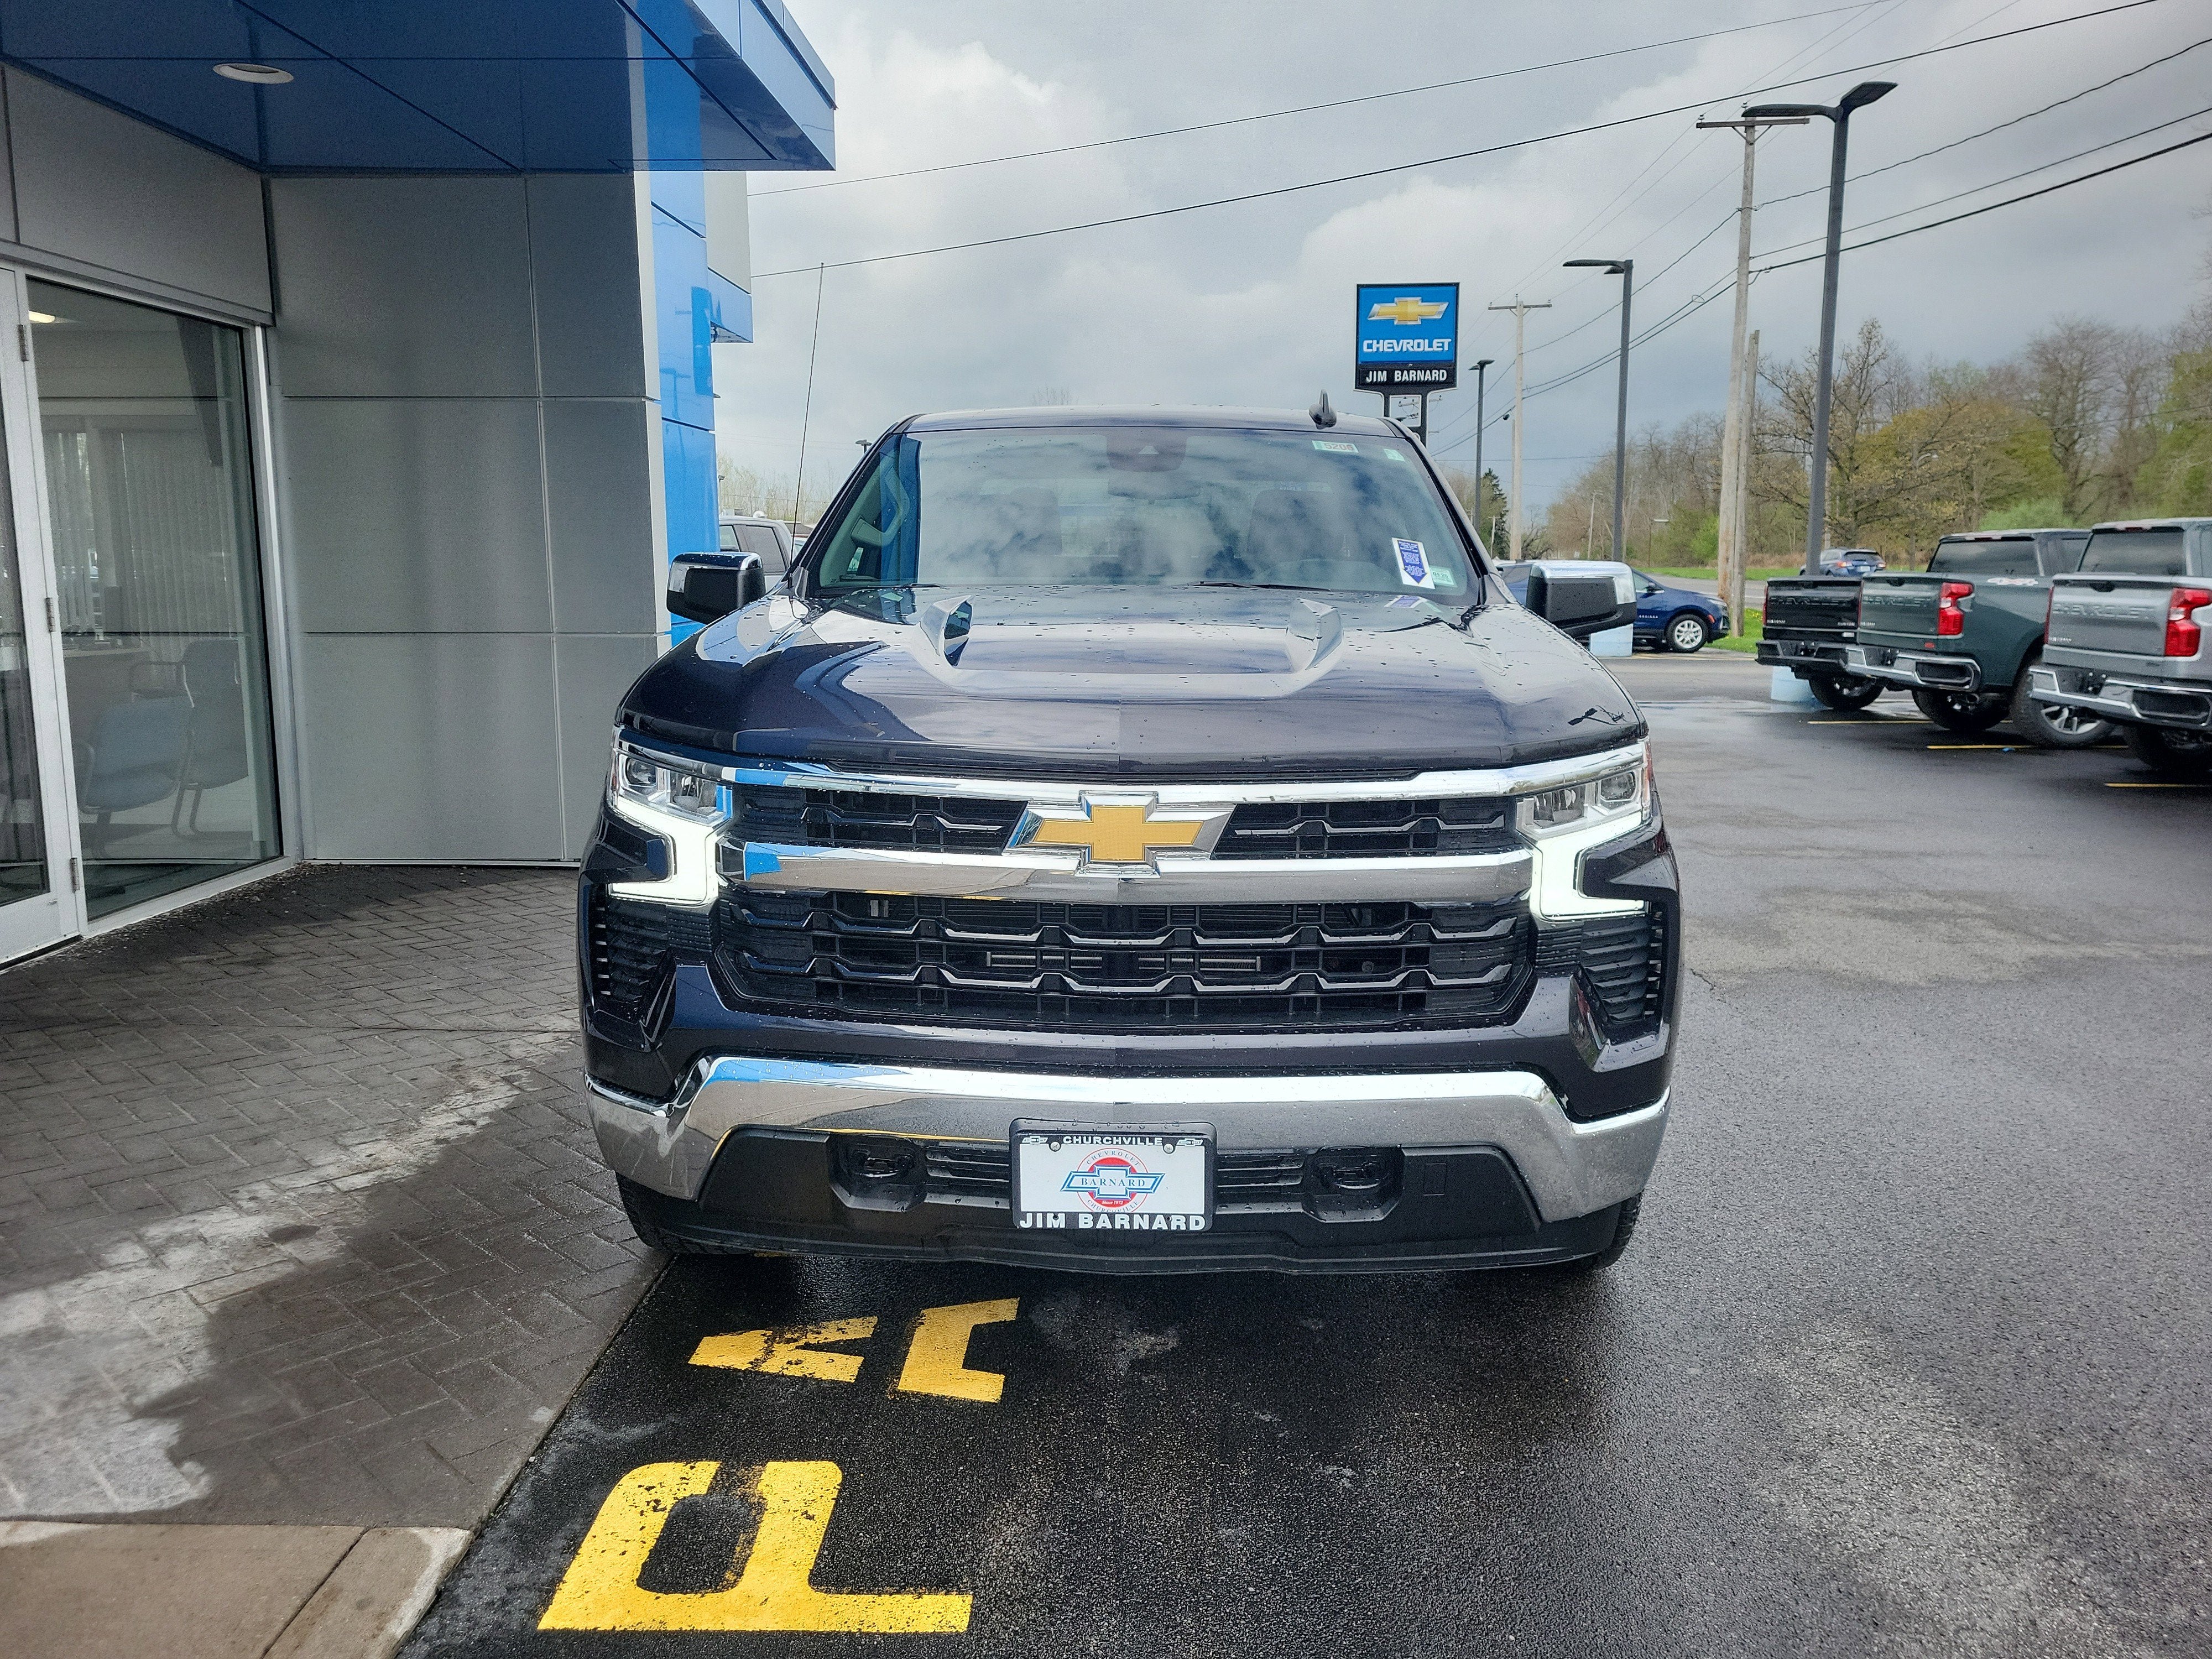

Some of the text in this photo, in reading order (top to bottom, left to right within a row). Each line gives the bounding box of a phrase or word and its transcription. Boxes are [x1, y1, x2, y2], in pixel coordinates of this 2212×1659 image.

[1363, 338, 1452, 352] CHEVROLET
[1366, 369, 1447, 382] JIM BARNARD
[1063, 1136, 1162, 1146] CHURCHVILLE
[1087, 1150, 1140, 1166] CHEVROLET
[1081, 1178, 1145, 1187] BARNARD
[1019, 1213, 1206, 1231] JIM BARNARD
